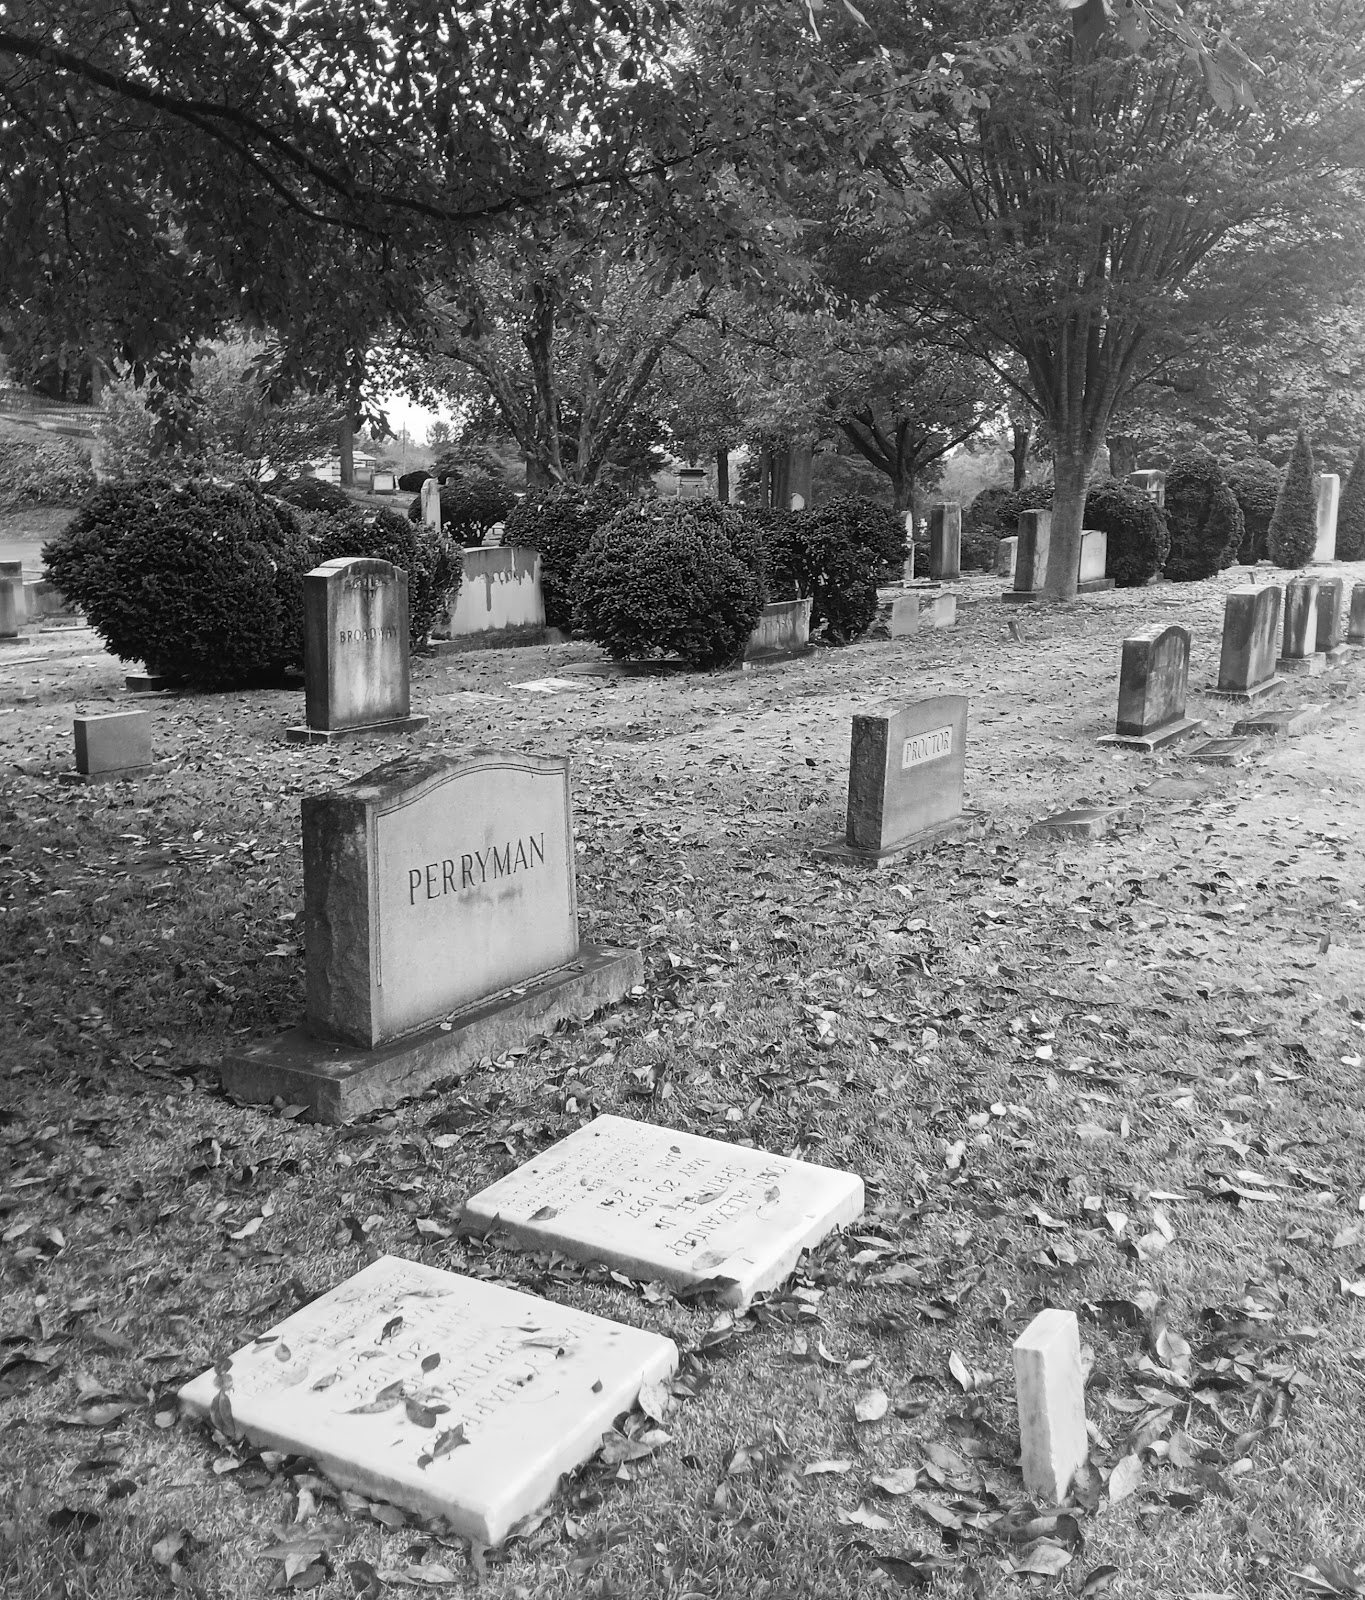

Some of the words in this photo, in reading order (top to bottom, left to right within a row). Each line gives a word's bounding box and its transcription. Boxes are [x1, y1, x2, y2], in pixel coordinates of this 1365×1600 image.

[340, 625, 398, 643] BROADWAY
[905, 731, 950, 763] PROCTOR
[408, 832, 544, 905] PERRYMAN
[674, 1157, 710, 1177] MAY
